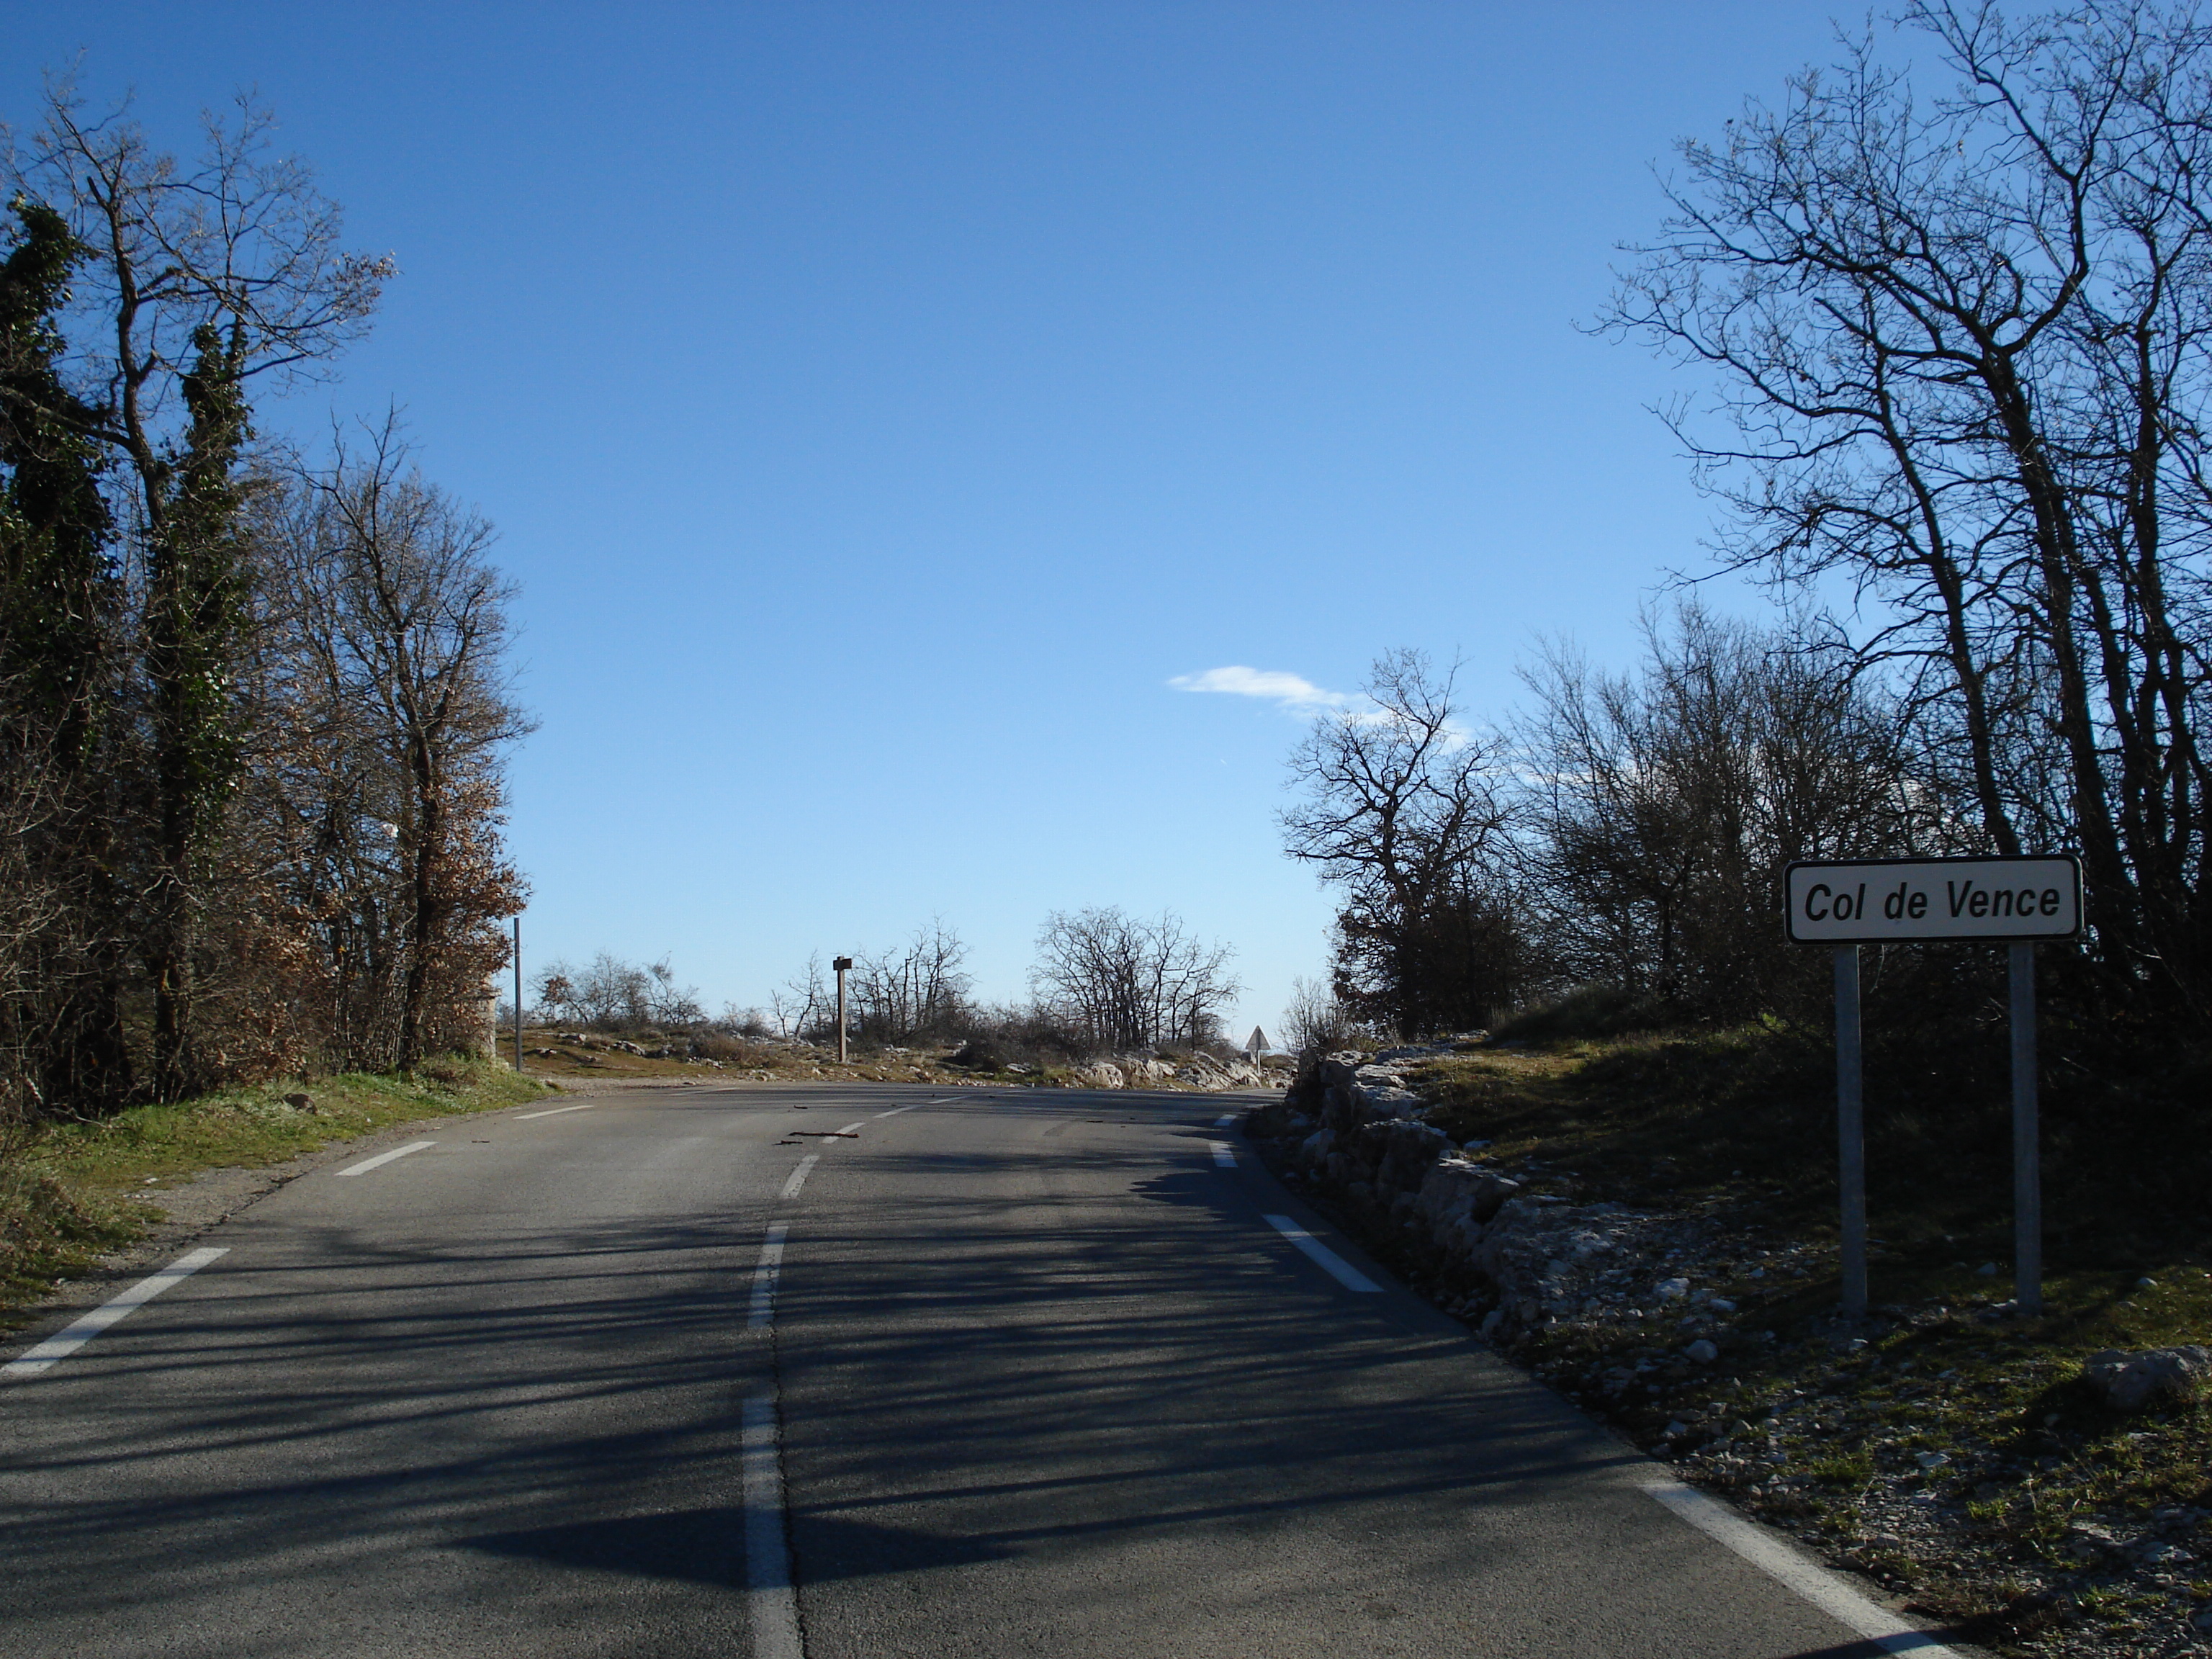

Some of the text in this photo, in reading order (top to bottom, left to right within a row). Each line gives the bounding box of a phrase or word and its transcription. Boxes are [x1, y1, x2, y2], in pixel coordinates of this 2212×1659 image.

[1805, 880, 2060, 921] Col de Vence
